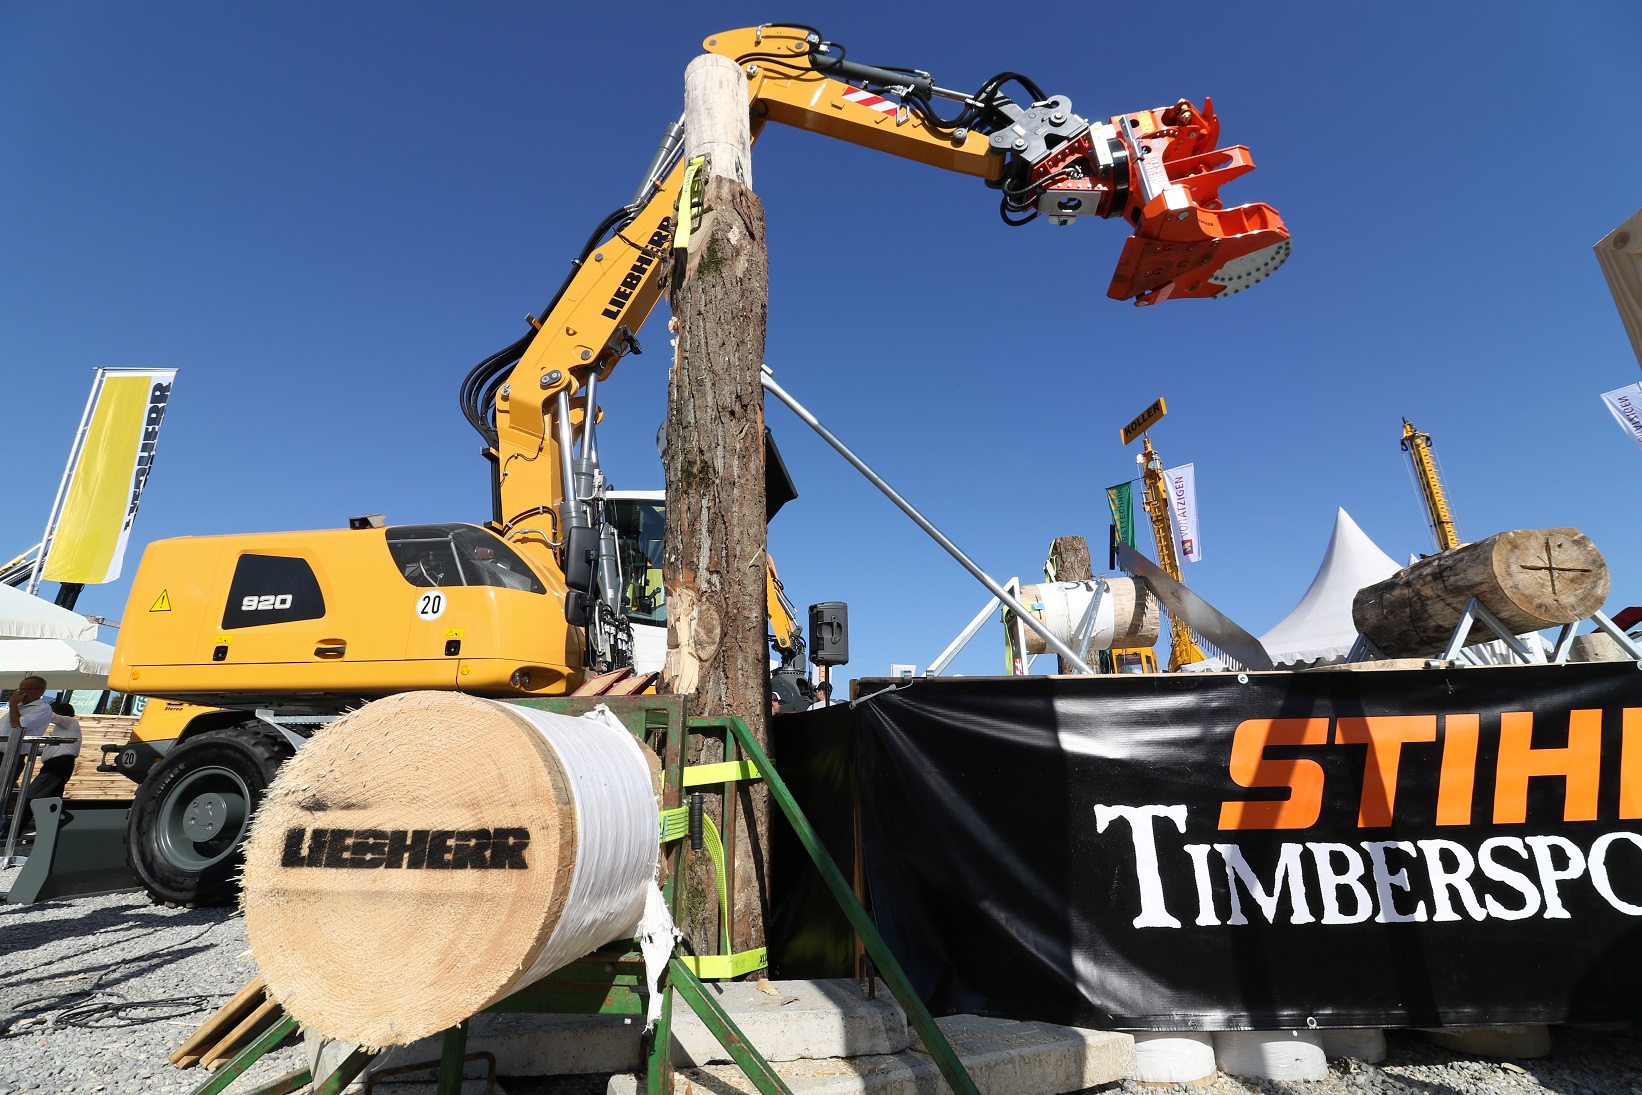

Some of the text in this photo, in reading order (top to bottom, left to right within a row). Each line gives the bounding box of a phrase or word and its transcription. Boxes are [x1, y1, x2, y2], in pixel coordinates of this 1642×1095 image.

[1123, 401, 1161, 437] KOLLER
[1117, 487, 1128, 543] RSTTECHNIK
[241, 594, 292, 611] 920
[421, 595, 441, 615] 20
[124, 752, 134, 764] 20
[281, 826, 531, 870] LIEBHERR
